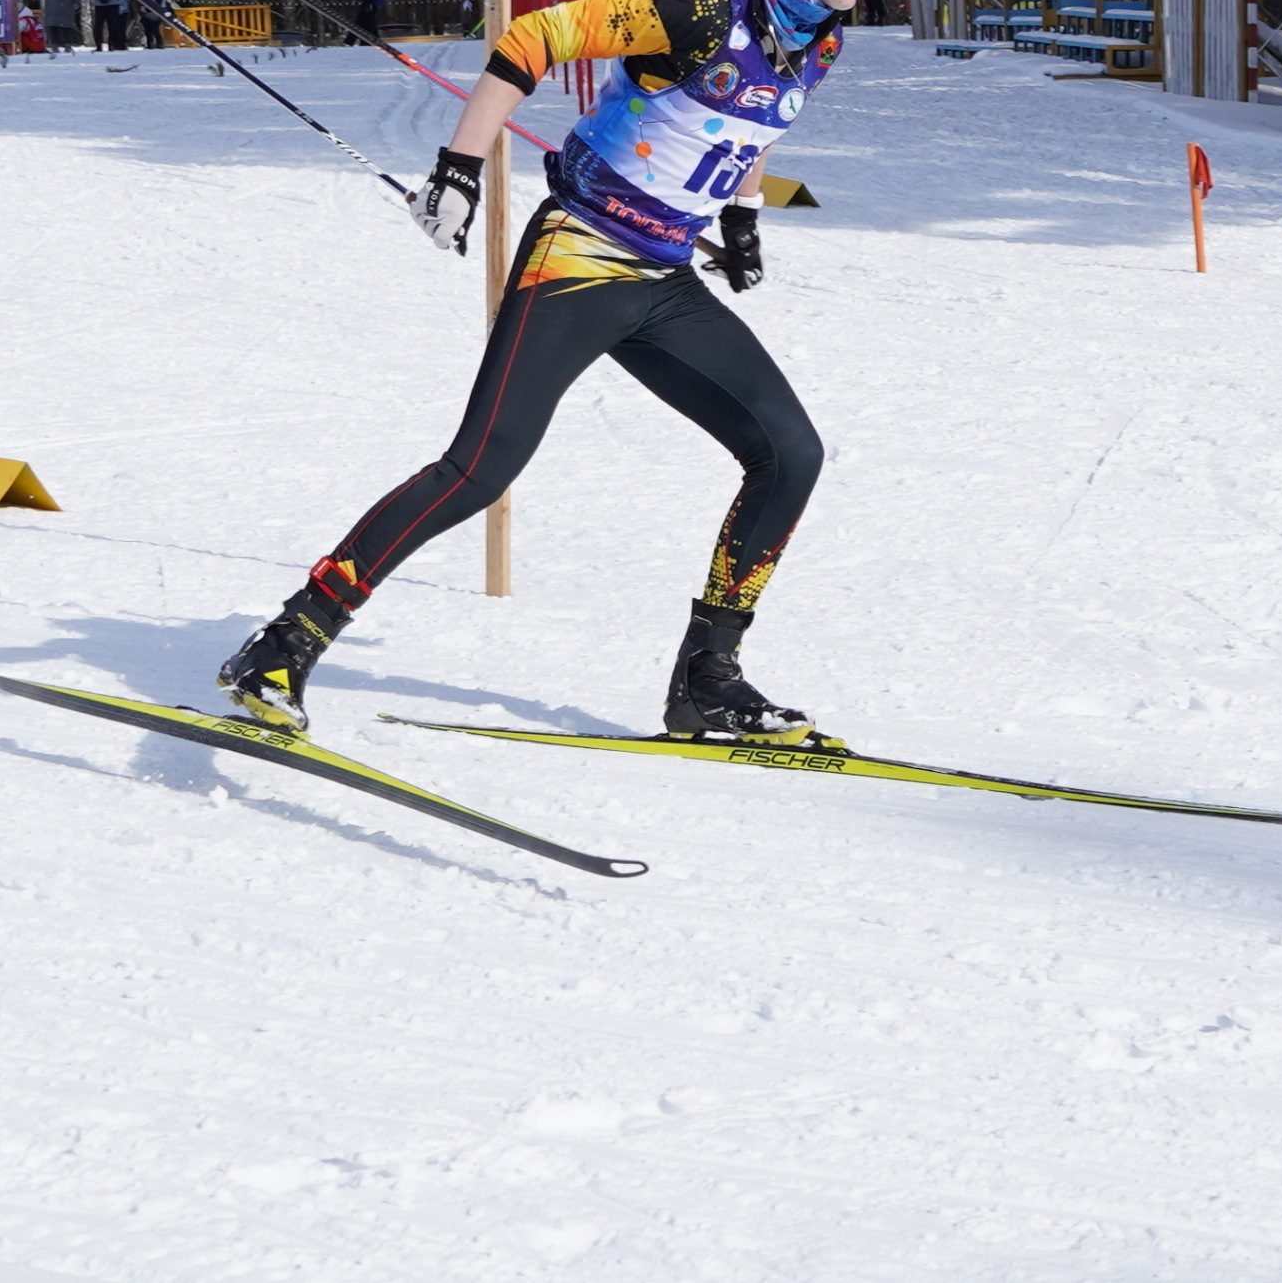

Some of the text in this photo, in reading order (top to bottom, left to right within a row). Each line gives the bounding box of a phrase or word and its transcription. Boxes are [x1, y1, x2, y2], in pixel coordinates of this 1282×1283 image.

[446, 169, 477, 189] MOAX
[212, 721, 296, 749] FISCHER
[728, 748, 846, 772] FISCHER
